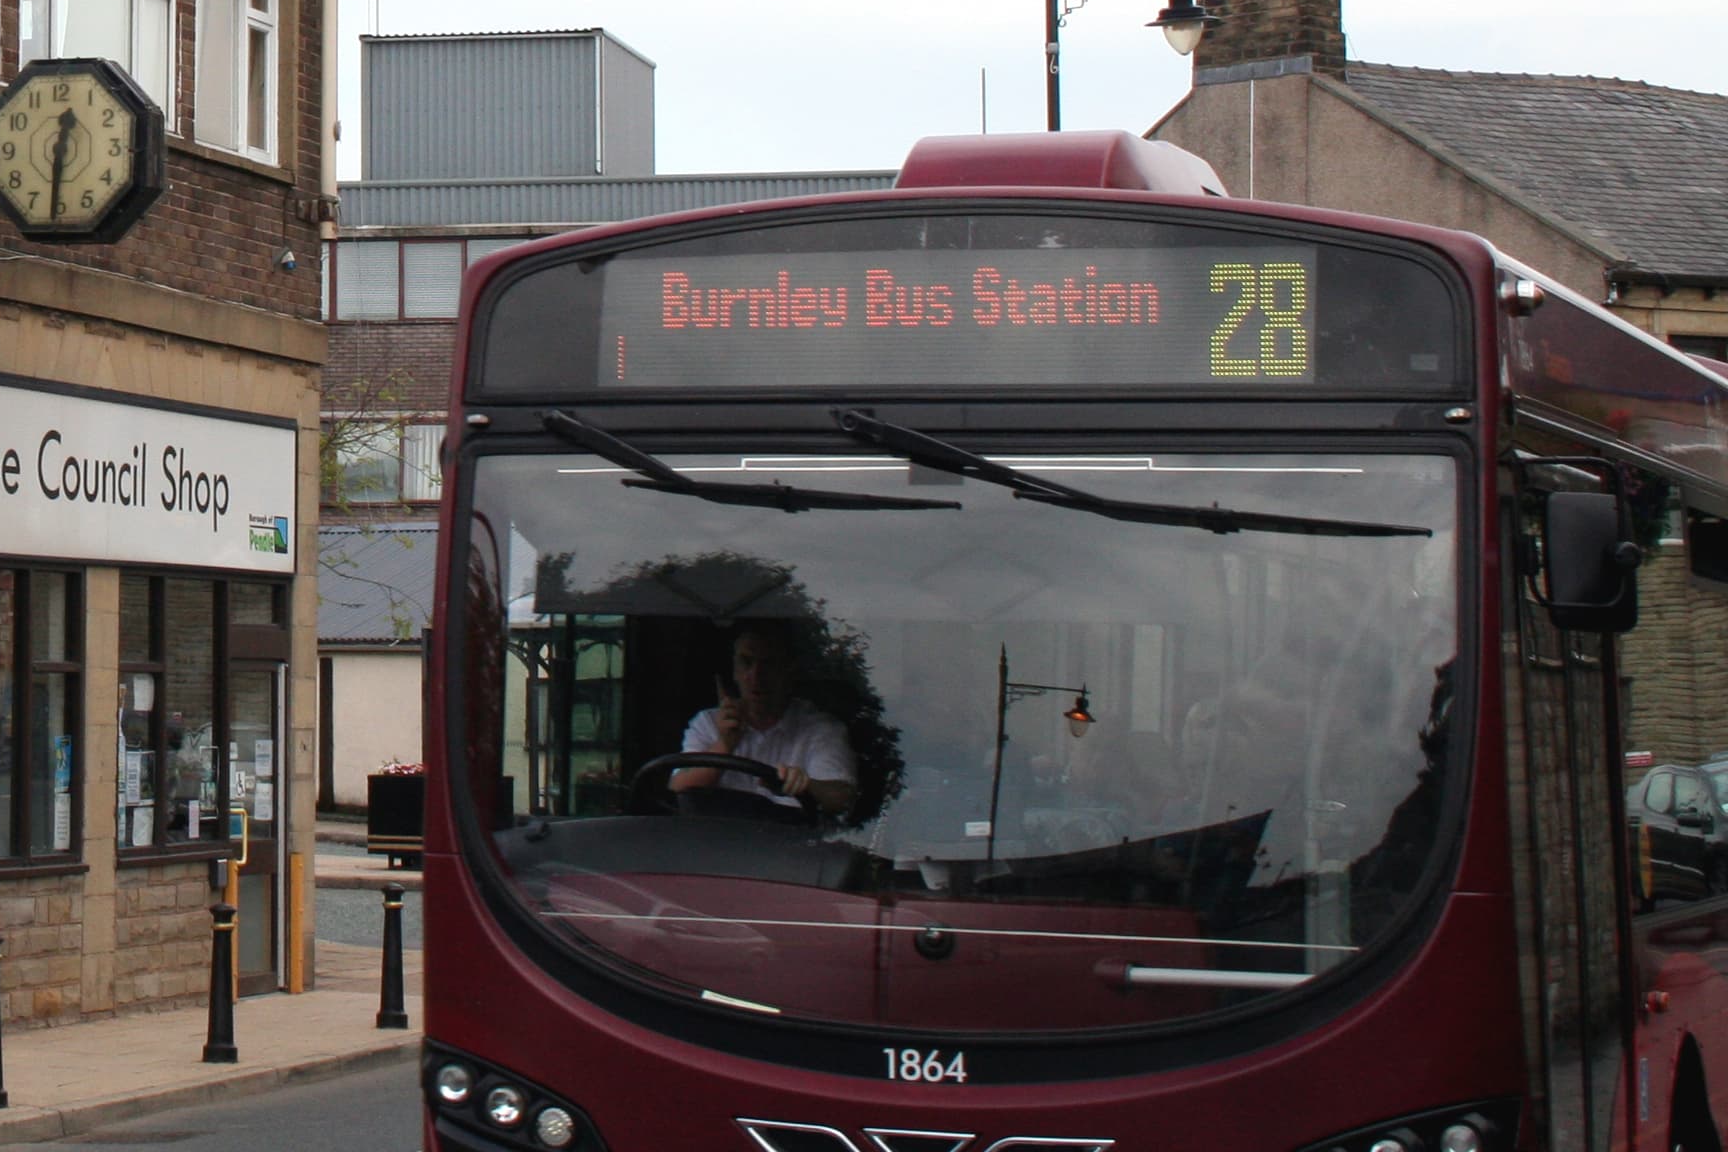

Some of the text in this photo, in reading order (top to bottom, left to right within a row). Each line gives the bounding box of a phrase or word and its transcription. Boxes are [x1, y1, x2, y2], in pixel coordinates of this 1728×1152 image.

[28, 91, 41, 110] 11
[52, 83, 71, 103] 12
[9, 112, 29, 132] 10
[102, 108, 115, 128] 2
[1, 141, 16, 161] 9
[108, 137, 122, 158] 3
[8, 169, 22, 190] 8
[99, 167, 113, 186] 4
[27, 191, 41, 210] 7
[80, 189, 95, 209] 5
[661, 264, 1161, 329] Burnley Bus Station
[1208, 261, 1308, 378] 28
[37, 429, 147, 508] Council
[160, 445, 230, 532] Shop
[882, 1048, 968, 1083] 1864
